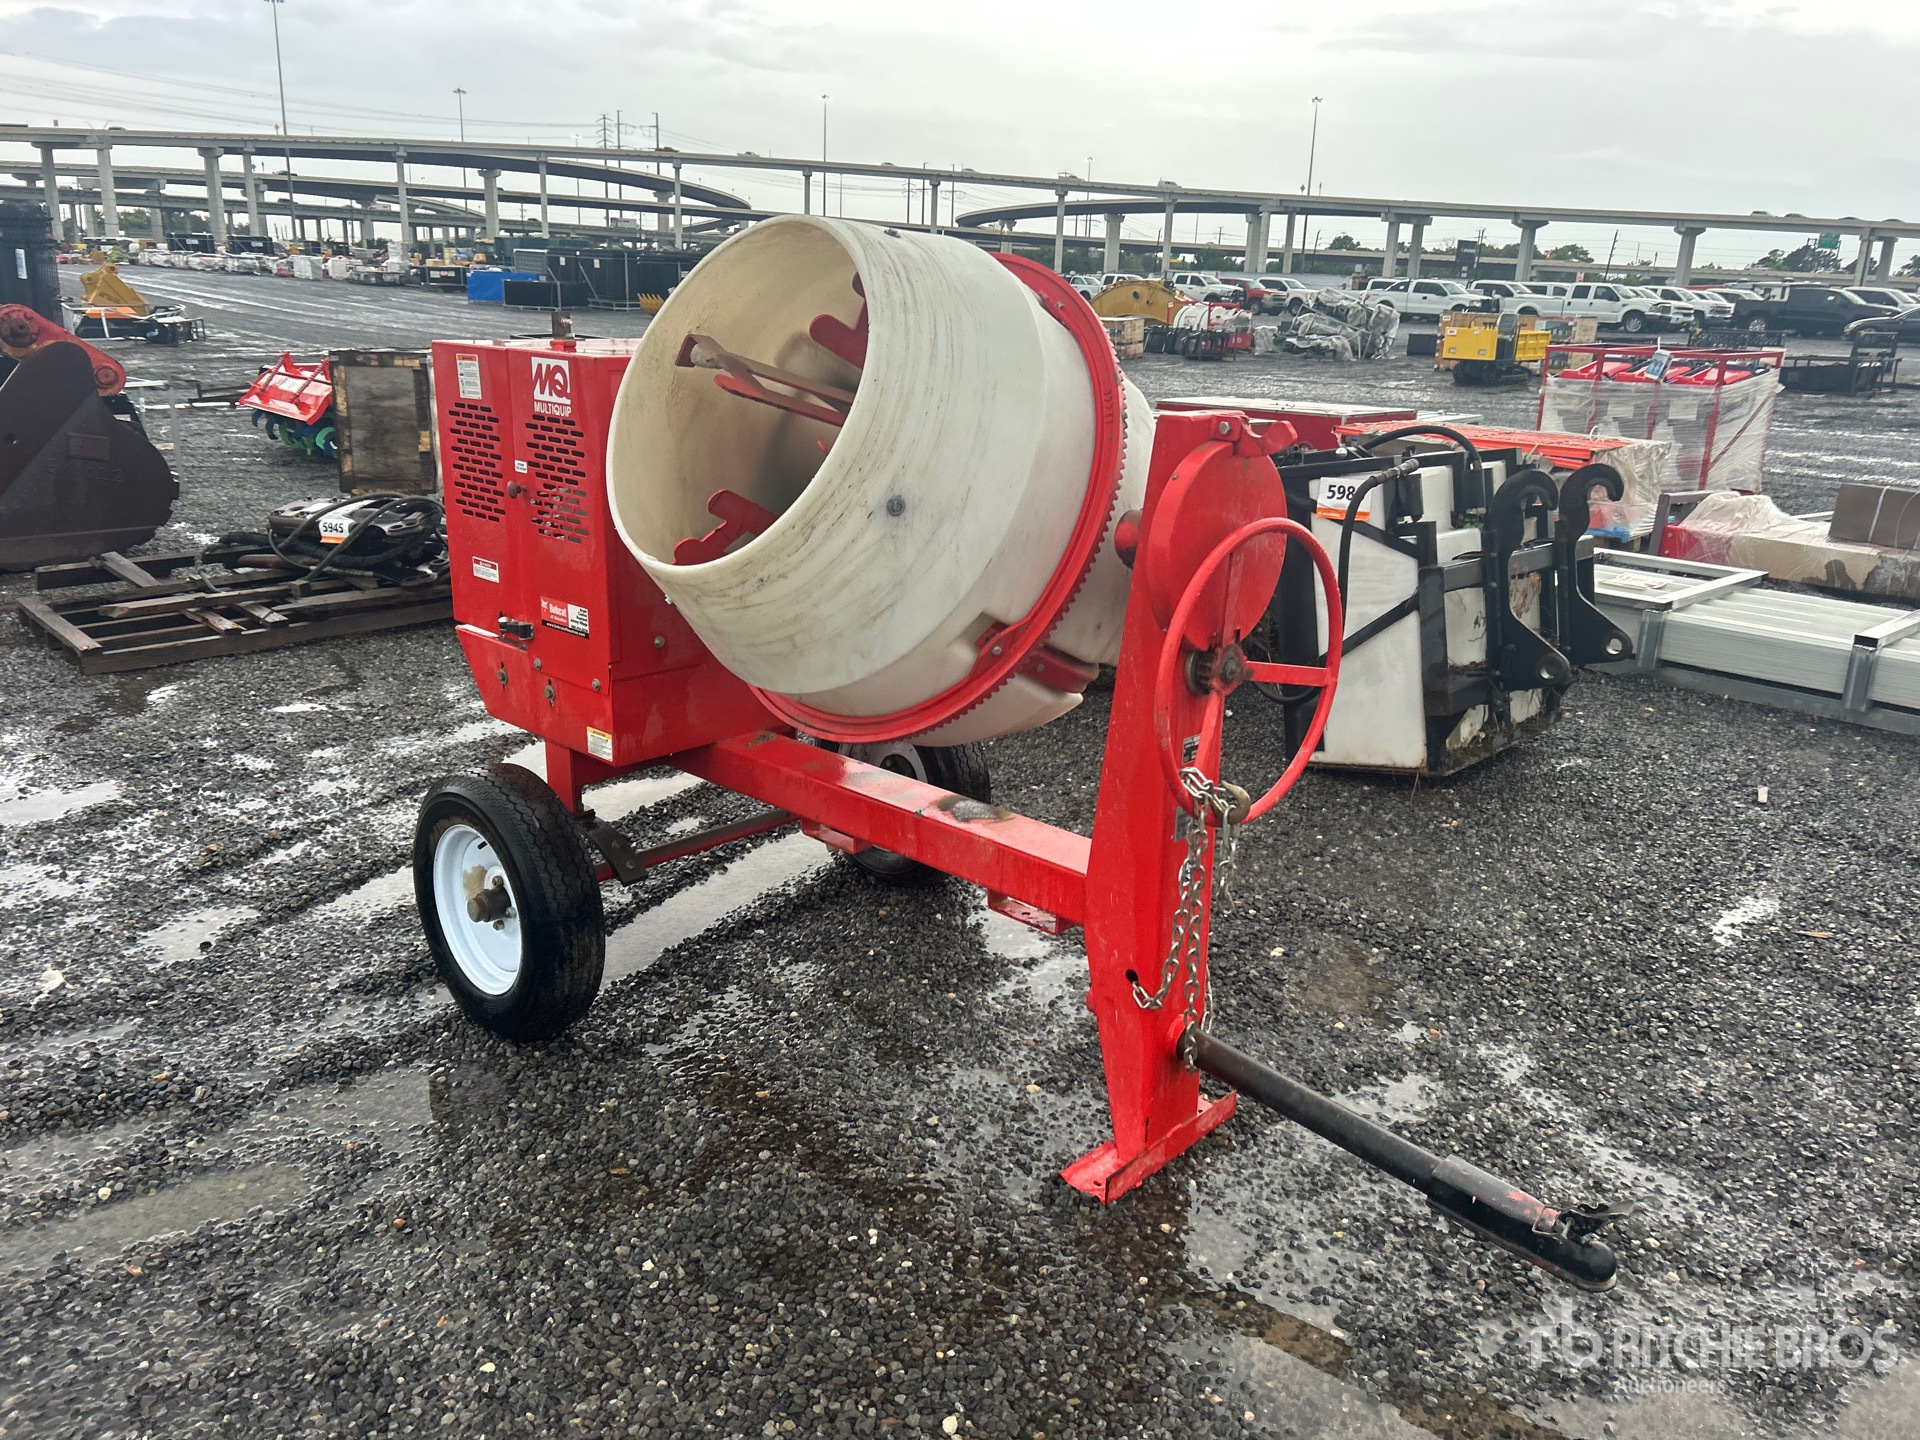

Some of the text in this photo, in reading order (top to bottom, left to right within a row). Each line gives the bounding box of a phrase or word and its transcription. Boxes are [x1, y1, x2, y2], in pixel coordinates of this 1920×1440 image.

[533, 362, 571, 400] MQ
[534, 401, 572, 417] MULTIQUIP
[322, 522, 344, 533] 5945
